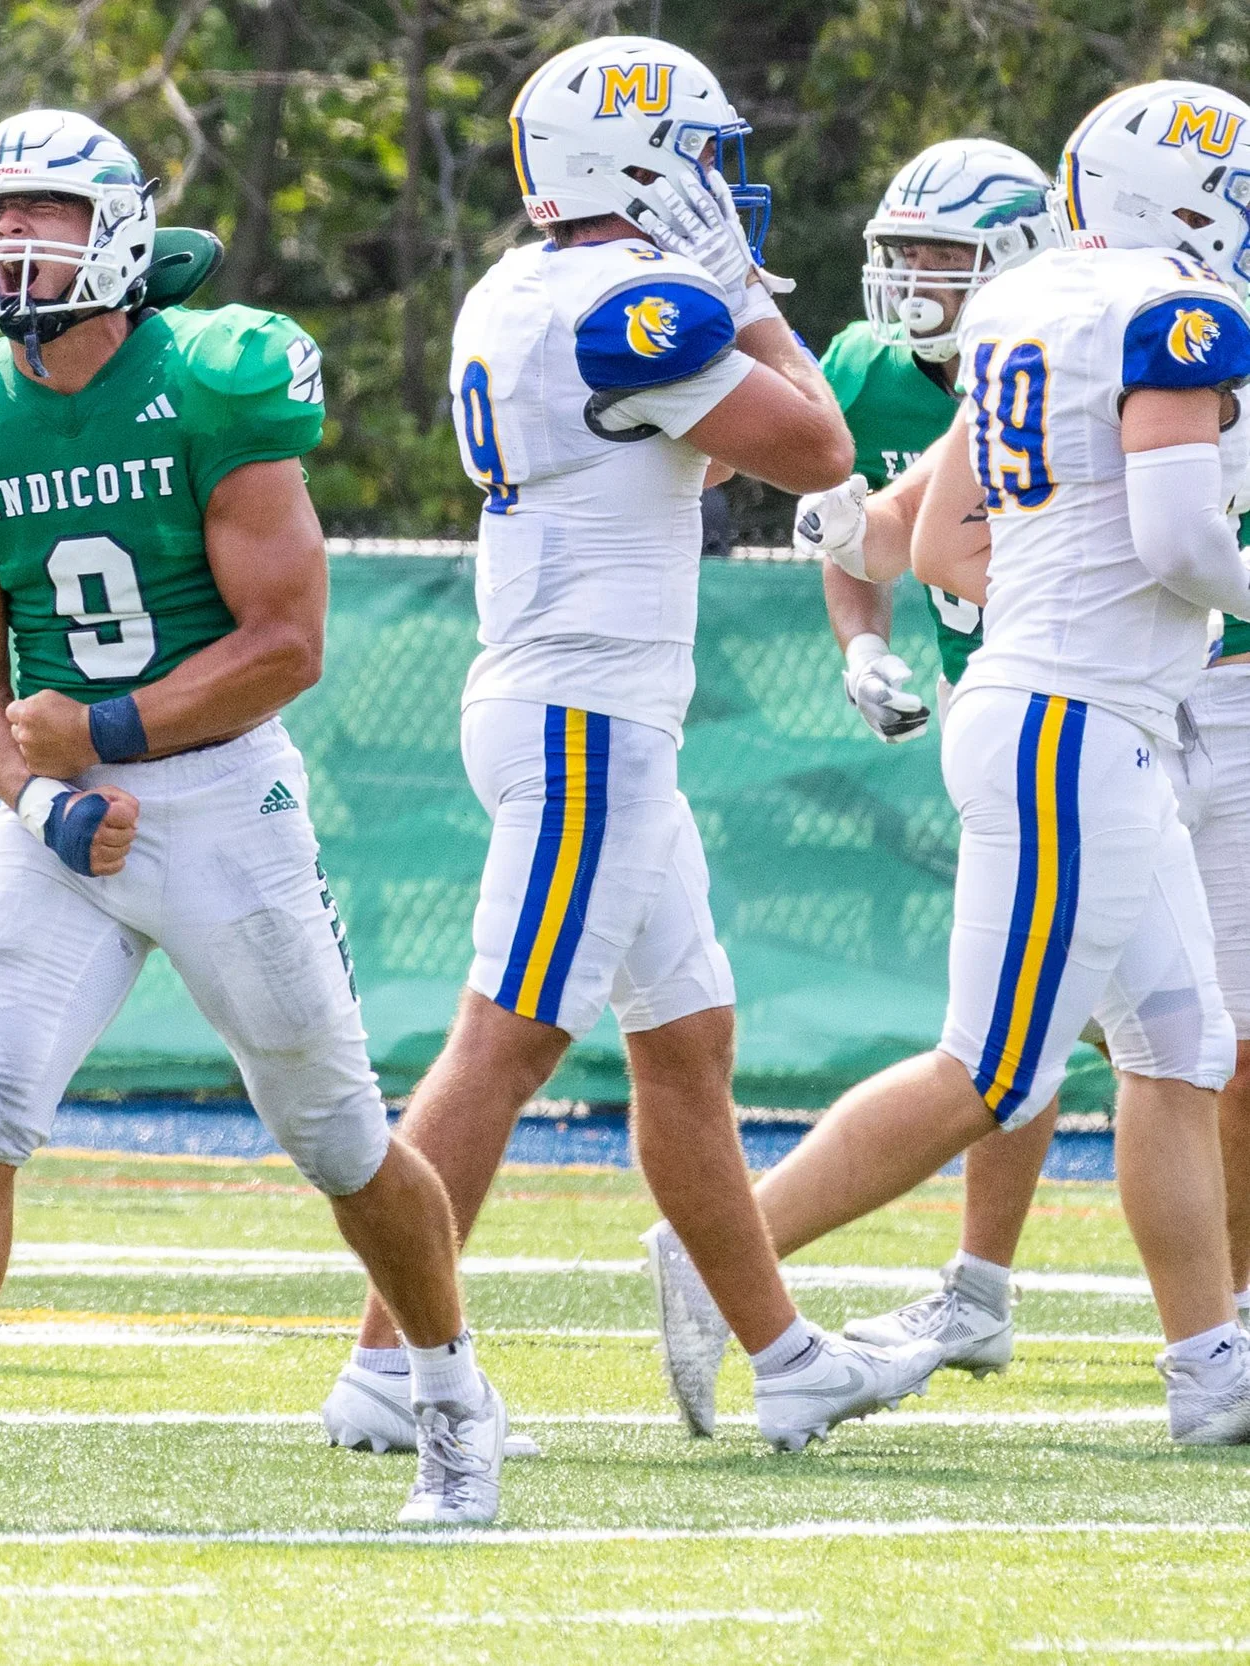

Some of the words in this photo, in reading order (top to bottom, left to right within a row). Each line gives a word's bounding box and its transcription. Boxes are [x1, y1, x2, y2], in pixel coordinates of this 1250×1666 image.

[594, 63, 677, 119] MU
[1157, 100, 1246, 161] MU
[527, 200, 561, 219] dell
[974, 338, 1058, 514] 19
[42, 531, 160, 682] 9
